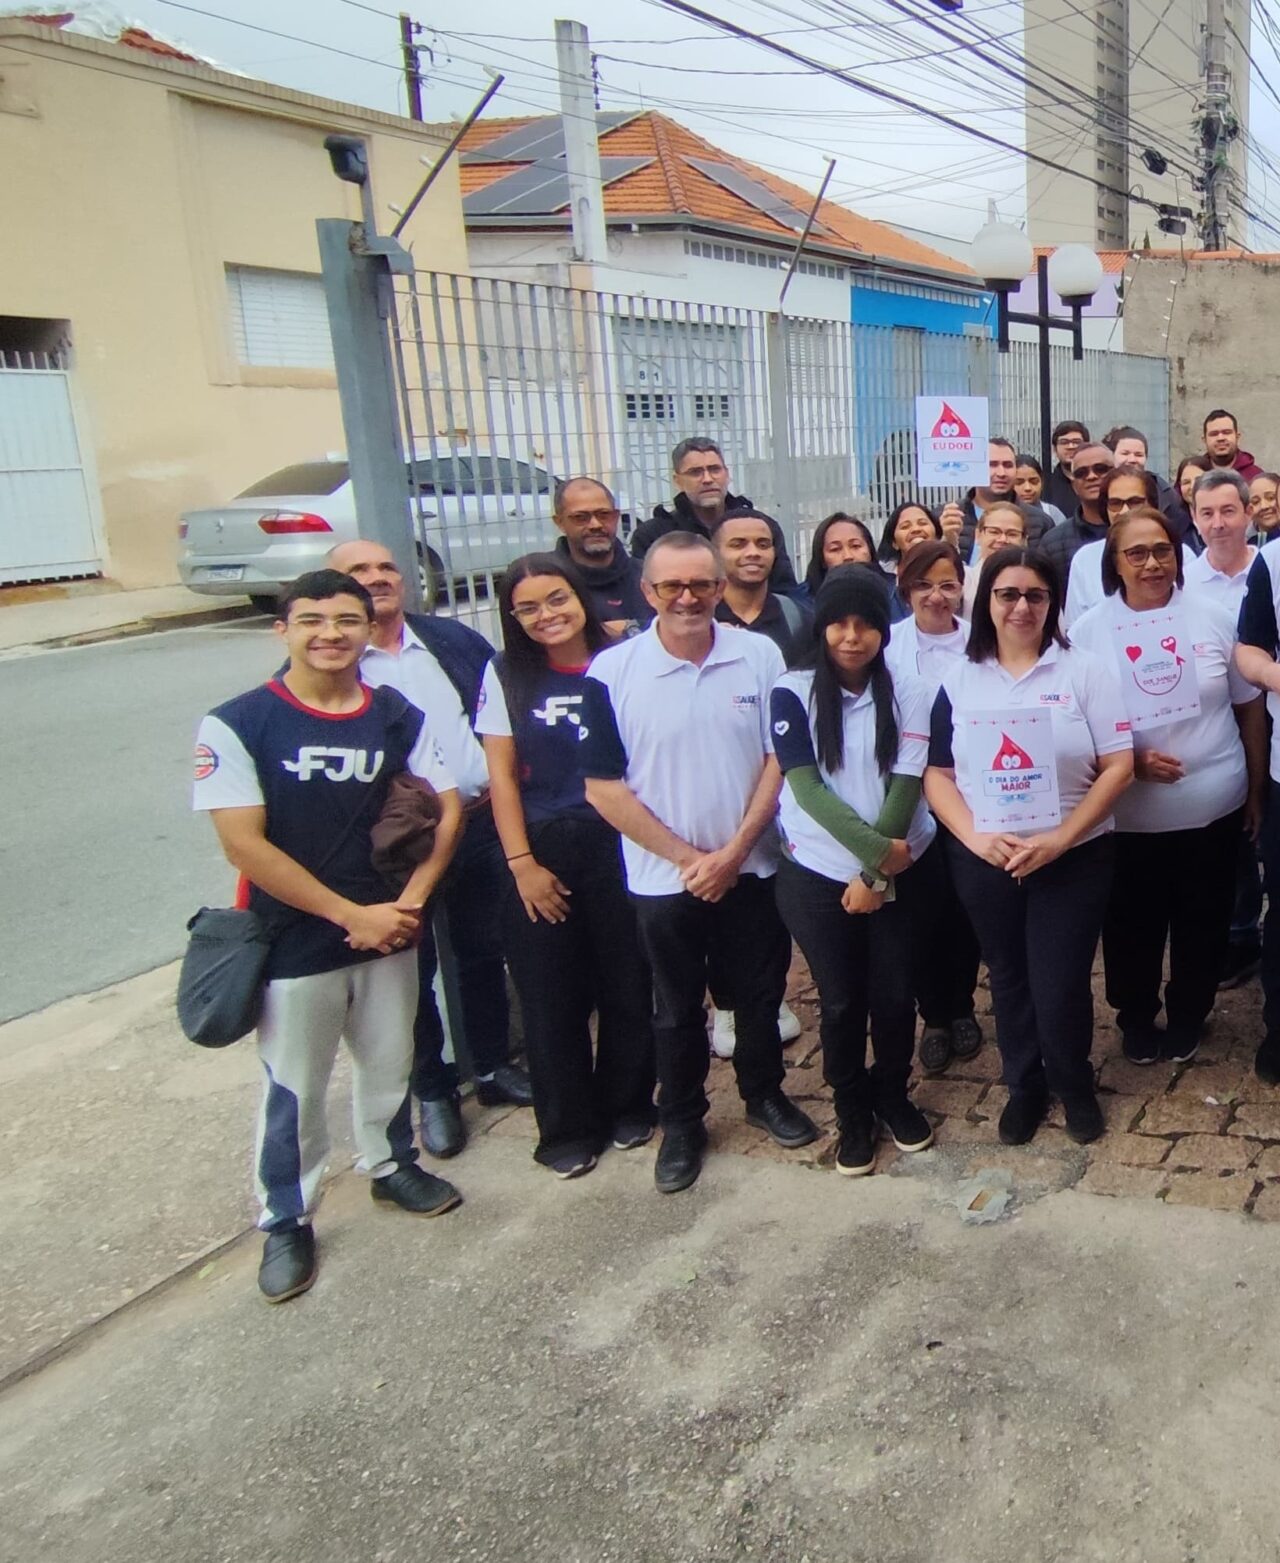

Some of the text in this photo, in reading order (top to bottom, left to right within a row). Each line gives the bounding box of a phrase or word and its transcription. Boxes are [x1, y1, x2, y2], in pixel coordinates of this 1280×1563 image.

[933, 442, 973, 450] EU DOEI
[283, 746, 385, 783] FJU
[1022, 773, 1042, 781] AMOR
[1001, 781, 1031, 791] MAIOR
